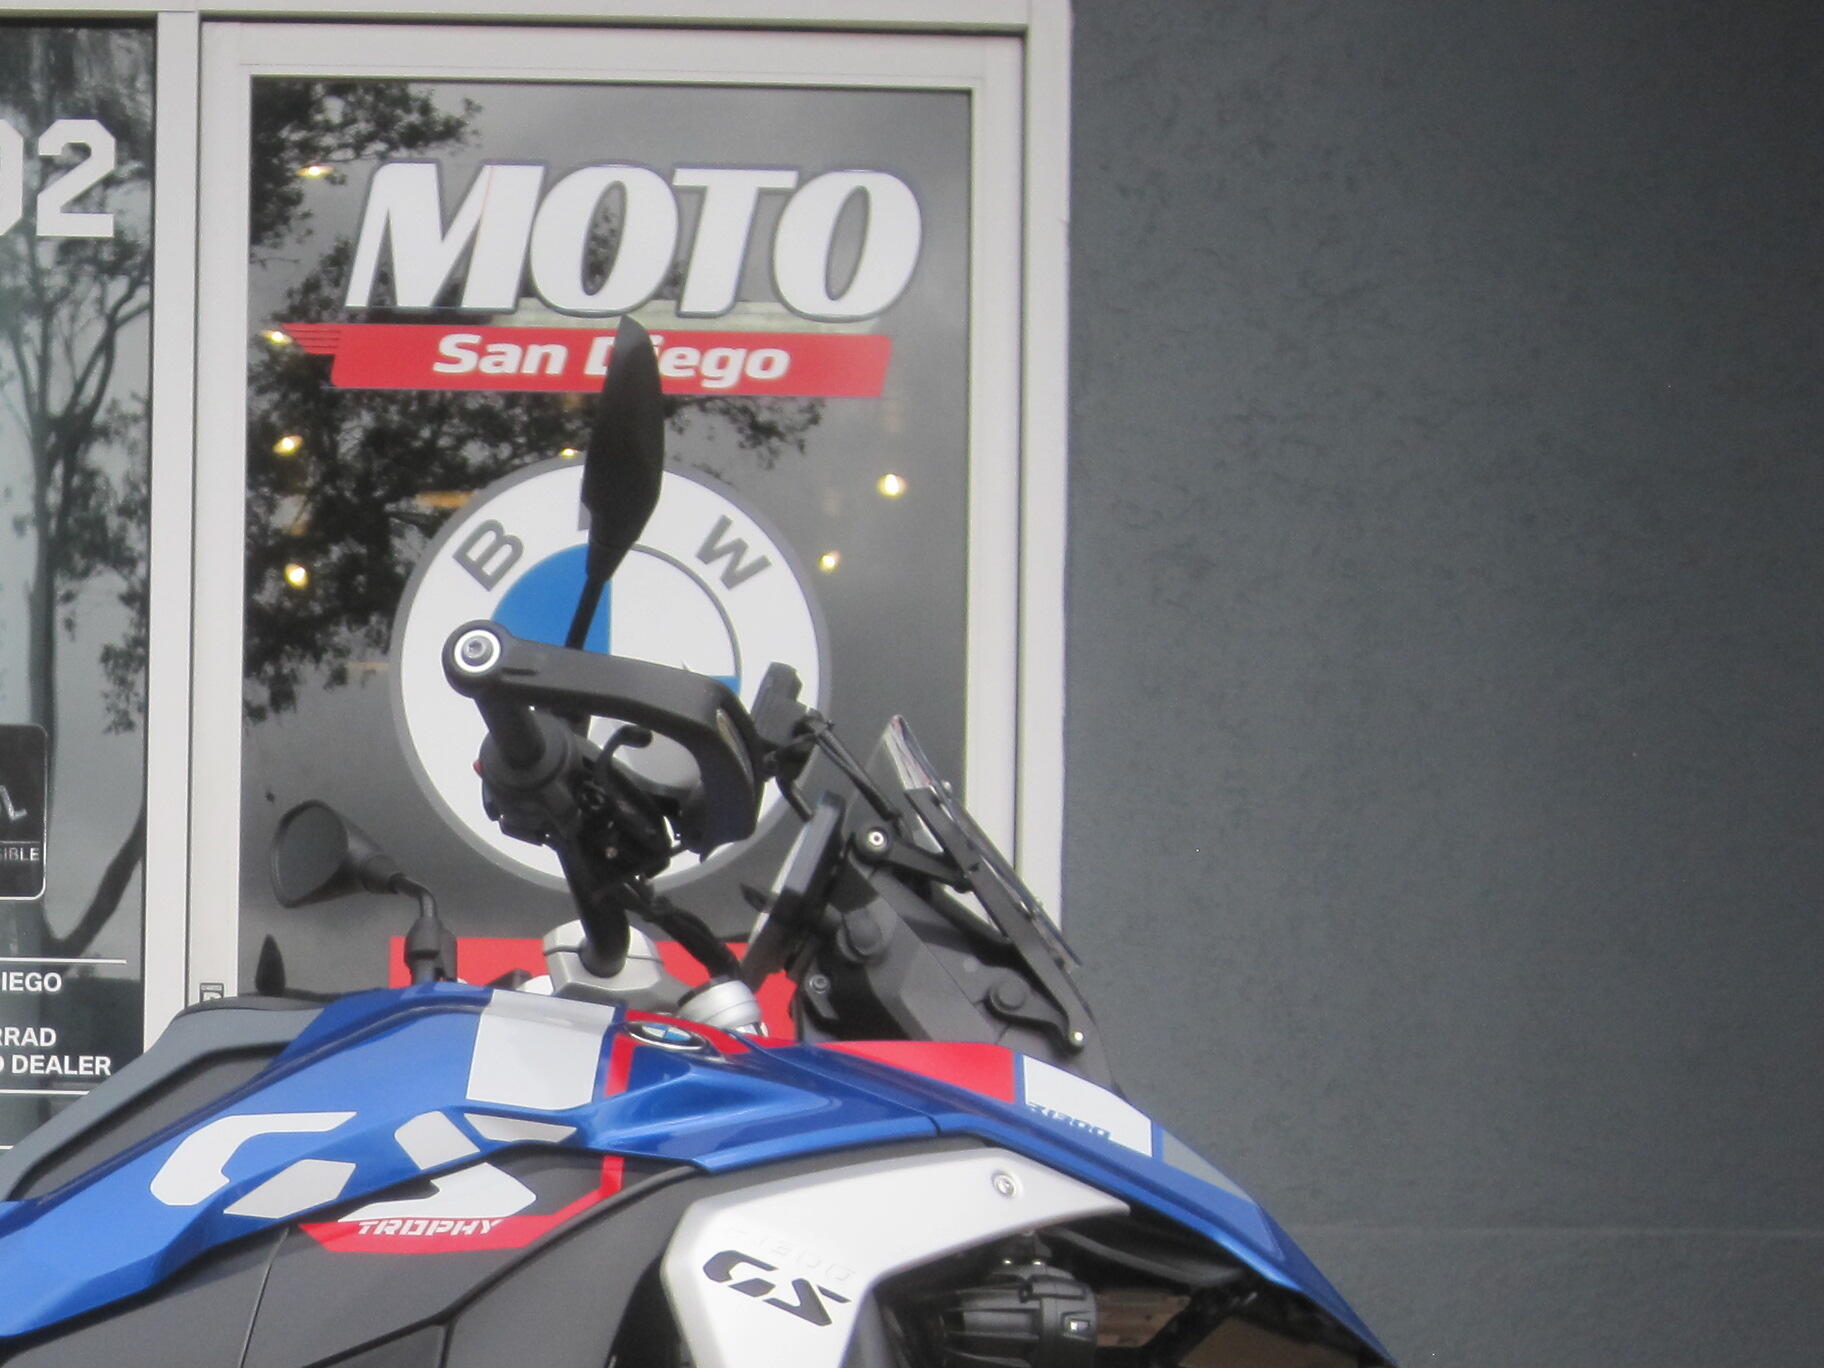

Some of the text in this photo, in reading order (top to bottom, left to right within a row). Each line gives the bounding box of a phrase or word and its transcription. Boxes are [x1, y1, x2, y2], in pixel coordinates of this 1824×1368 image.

[344, 162, 922, 322] MOTO
[433, 333, 791, 389] San Dego
[453, 500, 772, 592] BW
[12, 1054, 112, 1077] DEALER
[359, 1219, 504, 1236] TROPHY
